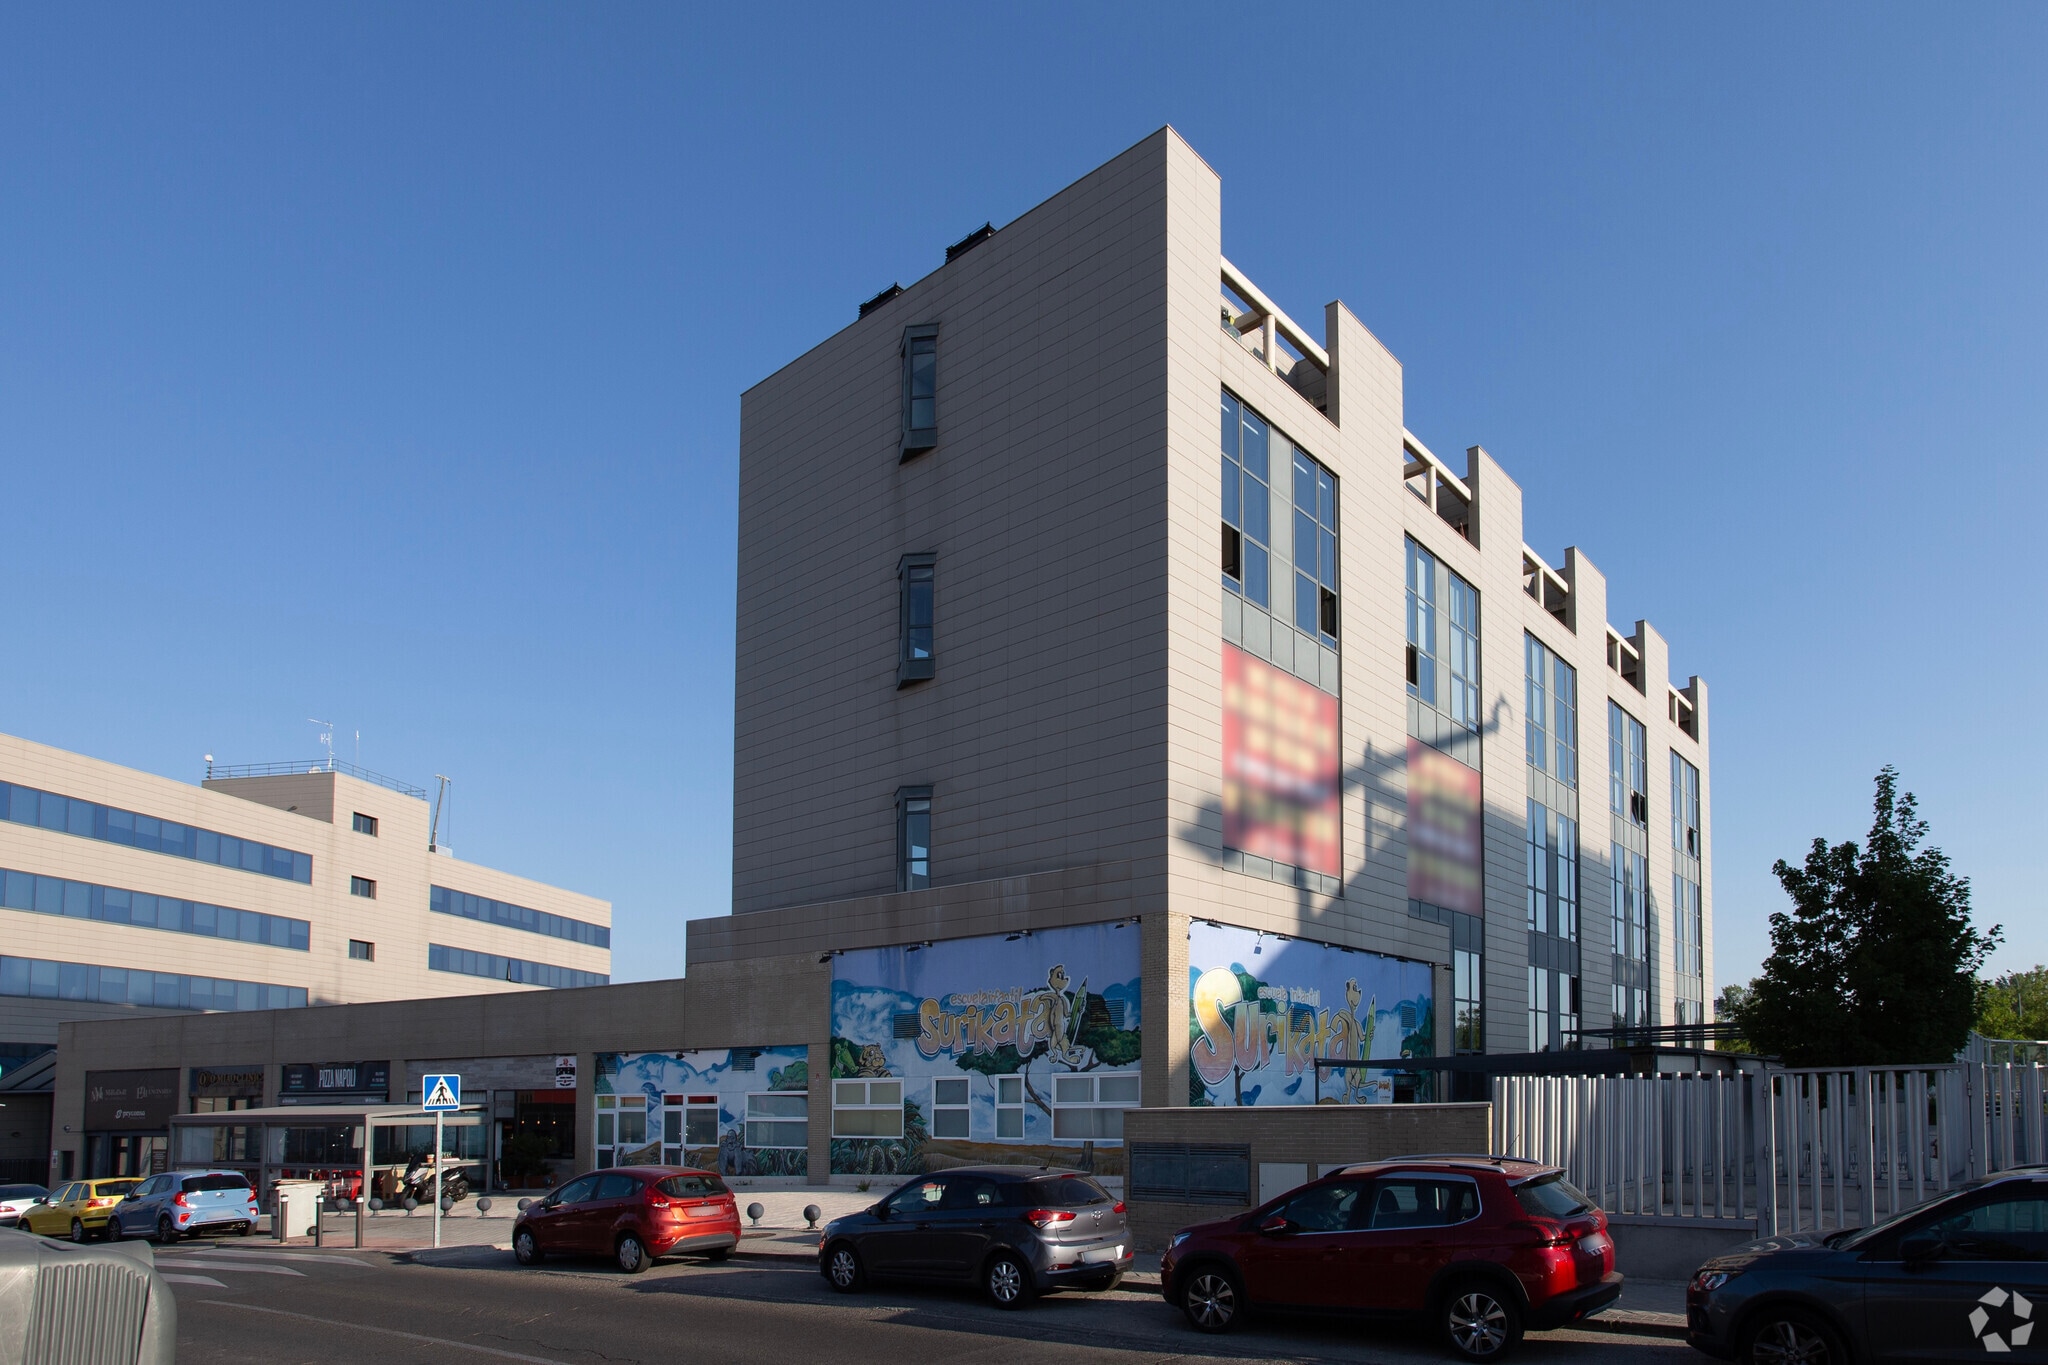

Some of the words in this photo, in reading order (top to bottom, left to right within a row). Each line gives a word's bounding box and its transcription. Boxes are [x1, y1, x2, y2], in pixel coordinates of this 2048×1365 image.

[1257, 985, 1288, 1001] escuela
[1289, 986, 1321, 1008] infantil
[916, 998, 1052, 1058] Surikata
[1190, 966, 1349, 1086] Surikata
[318, 1069, 334, 1088] PIZZA
[335, 1068, 356, 1087] NAPOLI
